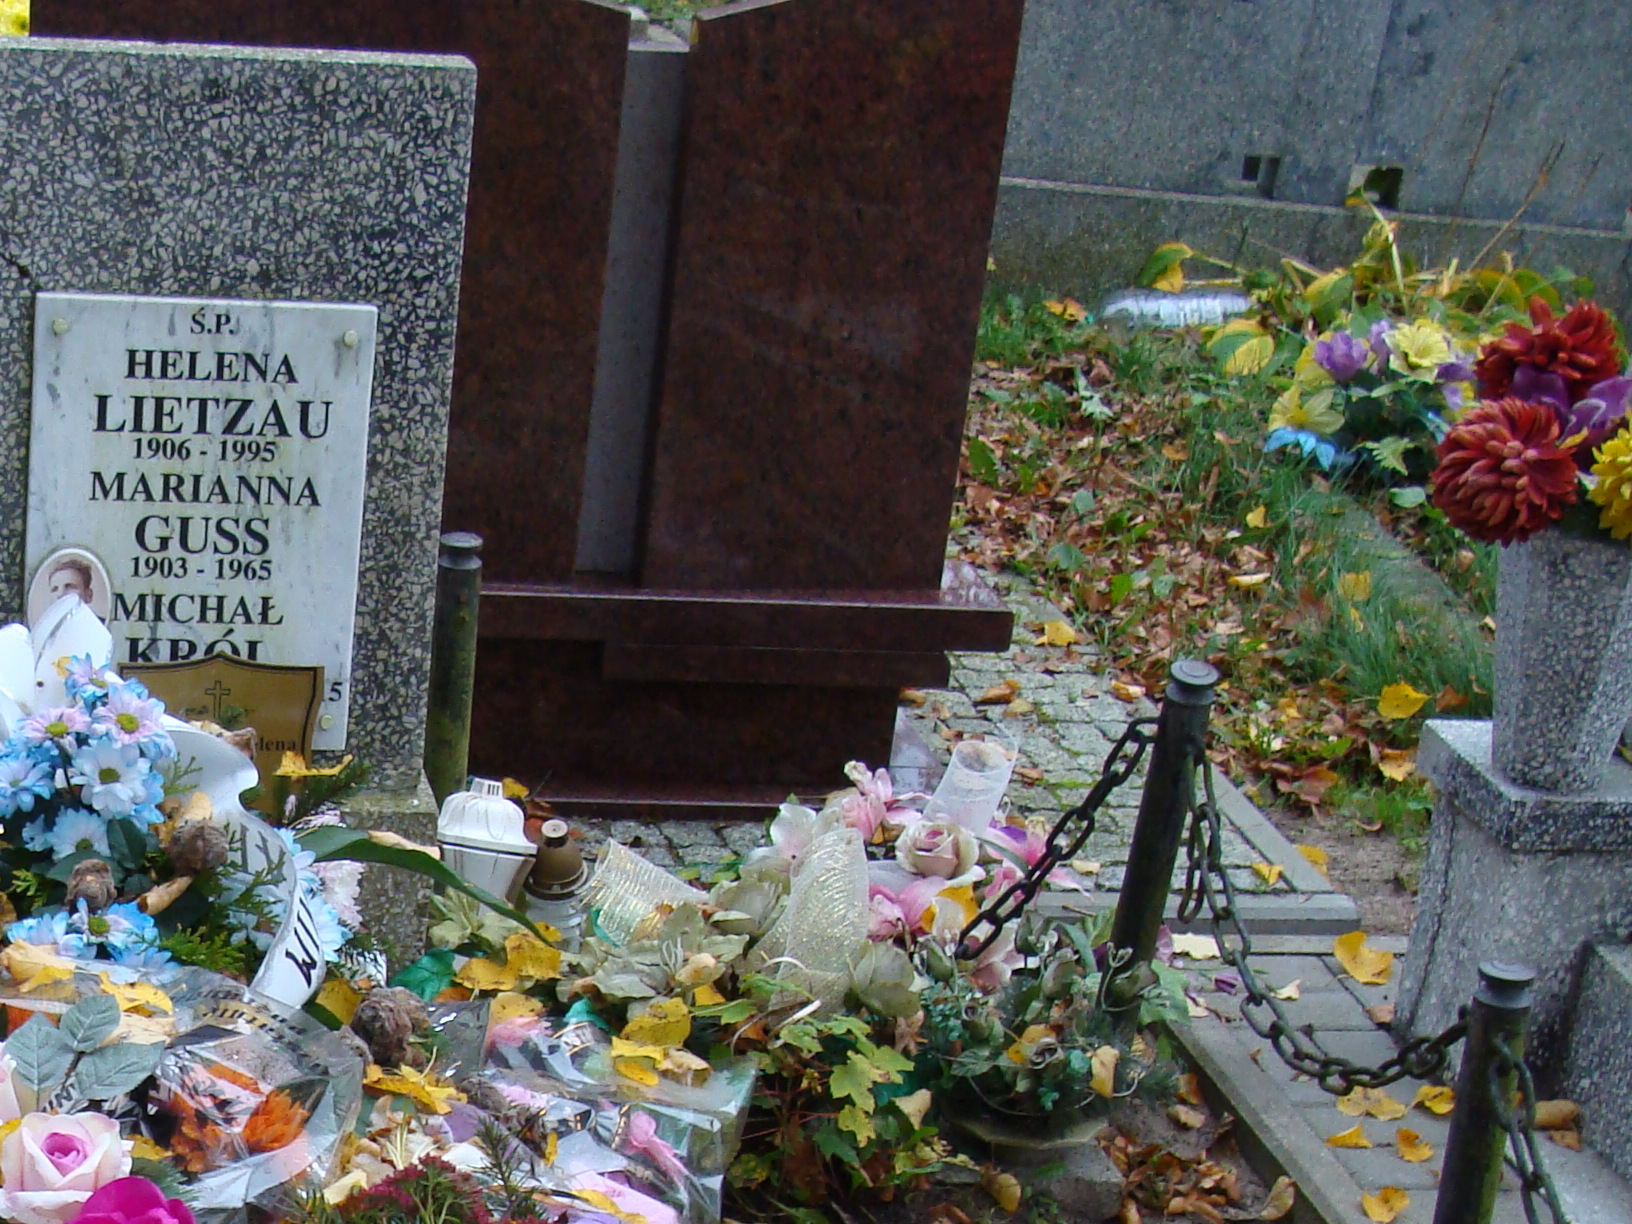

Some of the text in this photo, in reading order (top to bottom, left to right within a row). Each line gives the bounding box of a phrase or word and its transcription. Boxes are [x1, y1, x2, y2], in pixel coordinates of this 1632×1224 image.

[124, 349, 299, 384] HELENA
[92, 394, 334, 439] LIETZAU
[133, 437, 192, 461] 1906
[217, 440, 277, 463] 1995
[88, 471, 322, 507] MARIANNA
[134, 514, 270, 556] GUSS
[130, 556, 189, 579] 1903
[216, 558, 273, 581] 1965
[112, 592, 285, 626] MICHAŁ
